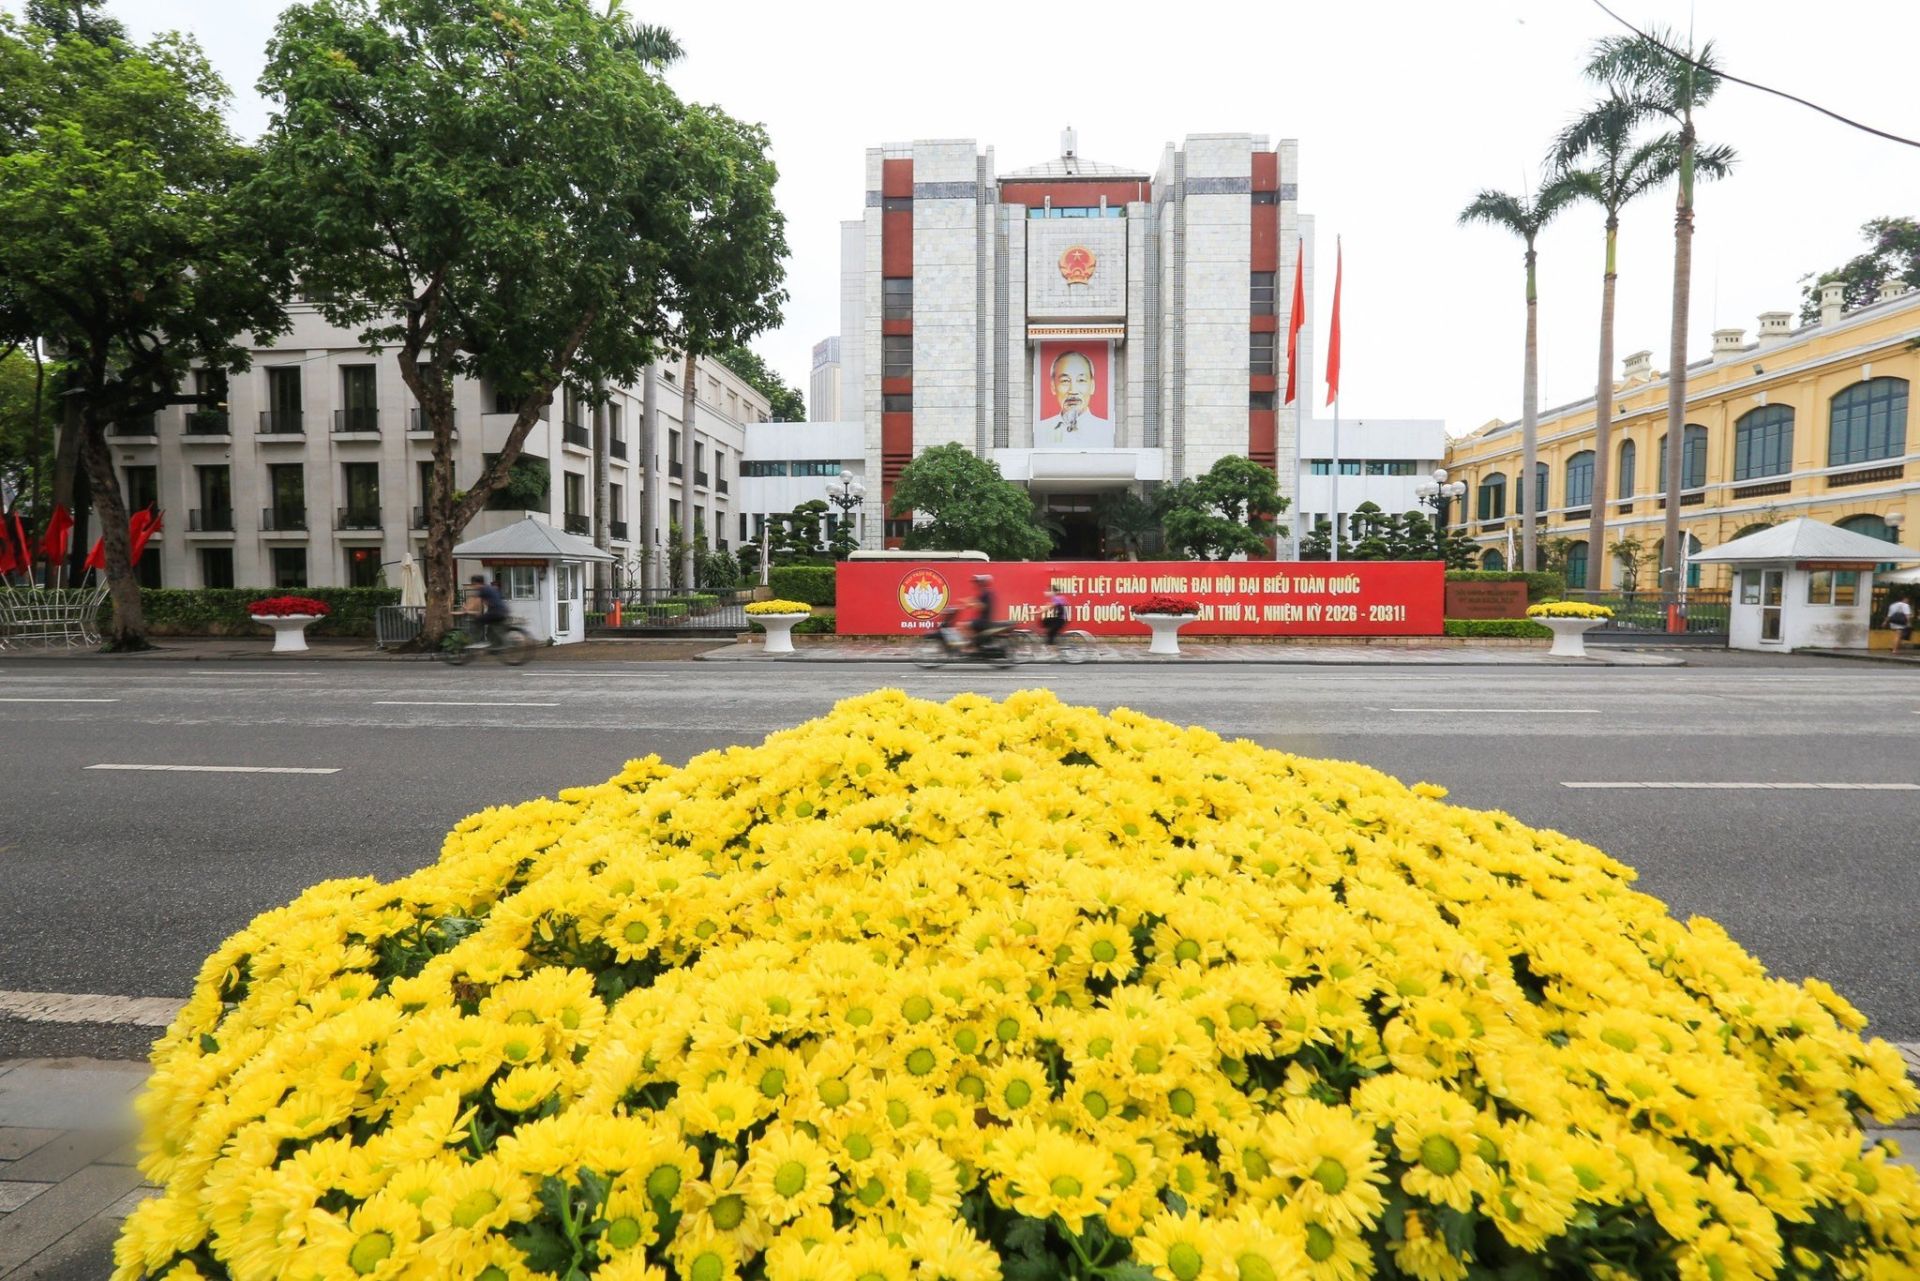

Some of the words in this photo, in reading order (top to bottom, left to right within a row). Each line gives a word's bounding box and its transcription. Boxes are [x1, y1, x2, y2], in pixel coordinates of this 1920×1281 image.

[1051, 575, 1085, 596] NHIỆT
[1088, 575, 1112, 596] LIỆT
[1116, 574, 1147, 593] CHÀO
[1151, 575, 1187, 593] MỪNG
[1191, 577, 1212, 595] ĐẠI
[1216, 575, 1235, 596] HỘI
[1239, 577, 1259, 595] ĐẠI
[1264, 572, 1289, 593] BIỂU
[1293, 574, 1325, 593] TOÀN
[1329, 573, 1360, 596] QUỐC
[1009, 603, 1037, 624] MẶT
[1075, 600, 1091, 621] TỔ
[1094, 601, 1125, 624] QUỐC
[1194, 601, 1214, 621] ẦN
[1218, 602, 1241, 621] THỨ
[1244, 605, 1260, 624] XI,
[1264, 603, 1302, 624] NHIỆM
[1306, 603, 1322, 621] KỲ
[1325, 605, 1357, 621] 2026
[1369, 605, 1405, 621] 2031!
[901, 621, 917, 630] ĐẠI
[919, 620, 935, 630] HỘI
